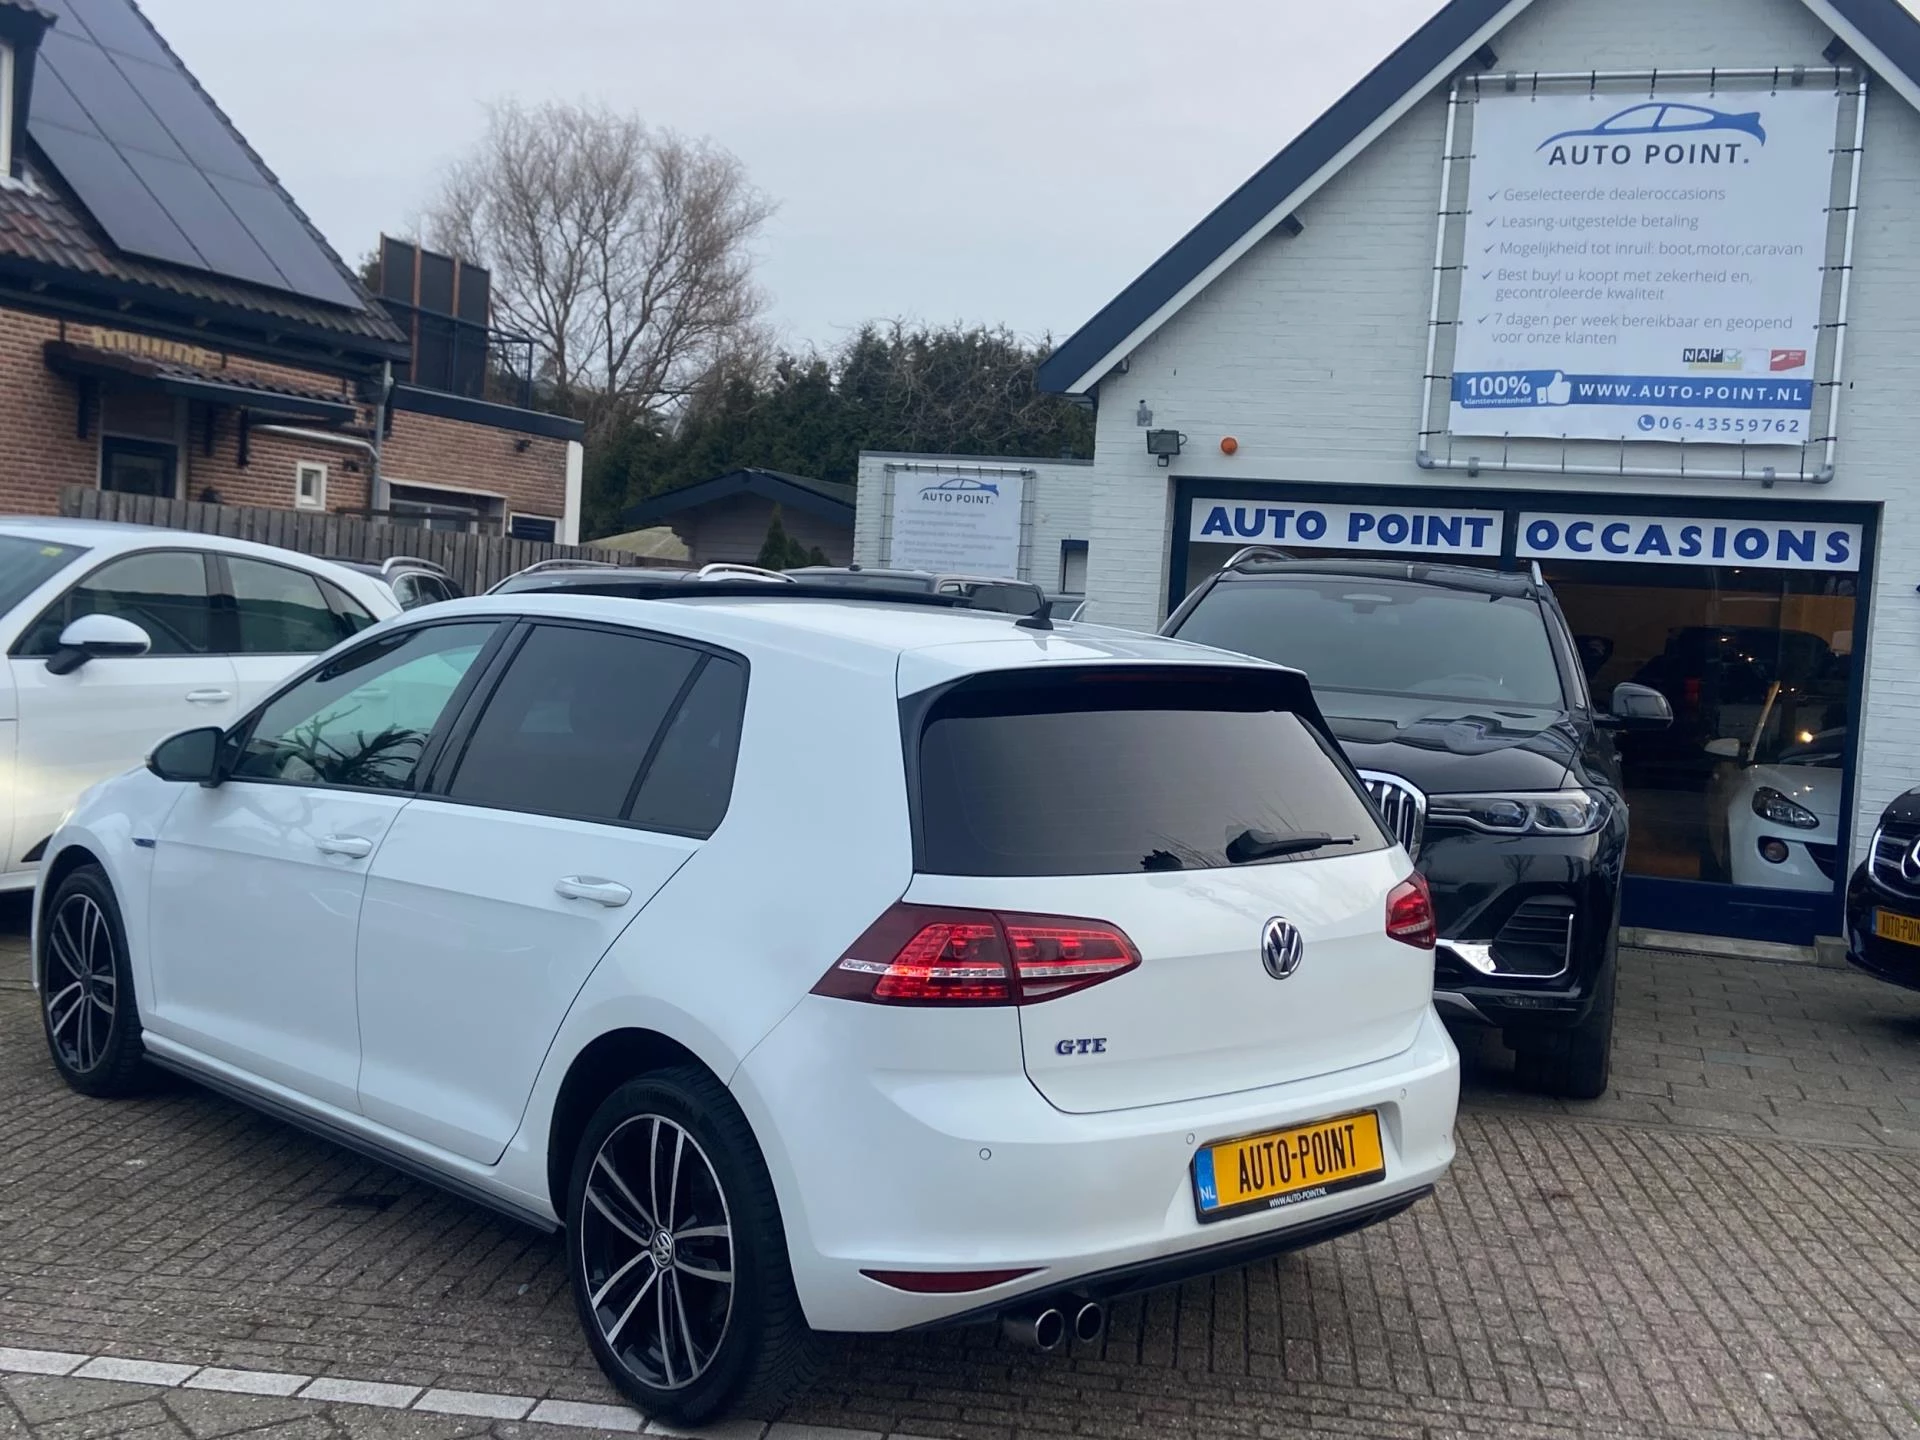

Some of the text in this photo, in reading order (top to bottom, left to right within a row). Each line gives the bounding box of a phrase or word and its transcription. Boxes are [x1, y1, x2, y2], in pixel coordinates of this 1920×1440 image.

[1548, 144, 1632, 166] AUTO
[1503, 186, 1726, 202] Geselecteerde dealeroccasions
[1641, 214, 1699, 231] betaling
[1499, 241, 1587, 258] Mogelijkheid
[1590, 242, 1609, 254] tot
[1497, 267, 1528, 282] Best
[1531, 267, 1562, 284] buy!
[1564, 271, 1575, 282] u
[1578, 268, 1619, 285] koopt
[1623, 270, 1651, 282] met
[1655, 268, 1728, 283] zekerheid
[1495, 286, 1665, 302] gecontroleerde kwaliteit
[1493, 312, 1794, 333] 7 dagen per week bereikbaar en geopend
[1491, 331, 1617, 345] voor onze klanten
[1683, 348, 1723, 362] NAP
[1465, 375, 1532, 396] 100%
[1578, 383, 1803, 402] WWW.AUTO-POINT.NL
[1658, 416, 1800, 433] 06-43559762
[921, 492, 953, 503] AUTO
[1200, 506, 1494, 548] AUTO POINT
[1525, 519, 1851, 564] OCCASIONS
[1056, 1037, 1108, 1055] GTE
[1199, 1124, 1357, 1200] NL AUTO-POINT
